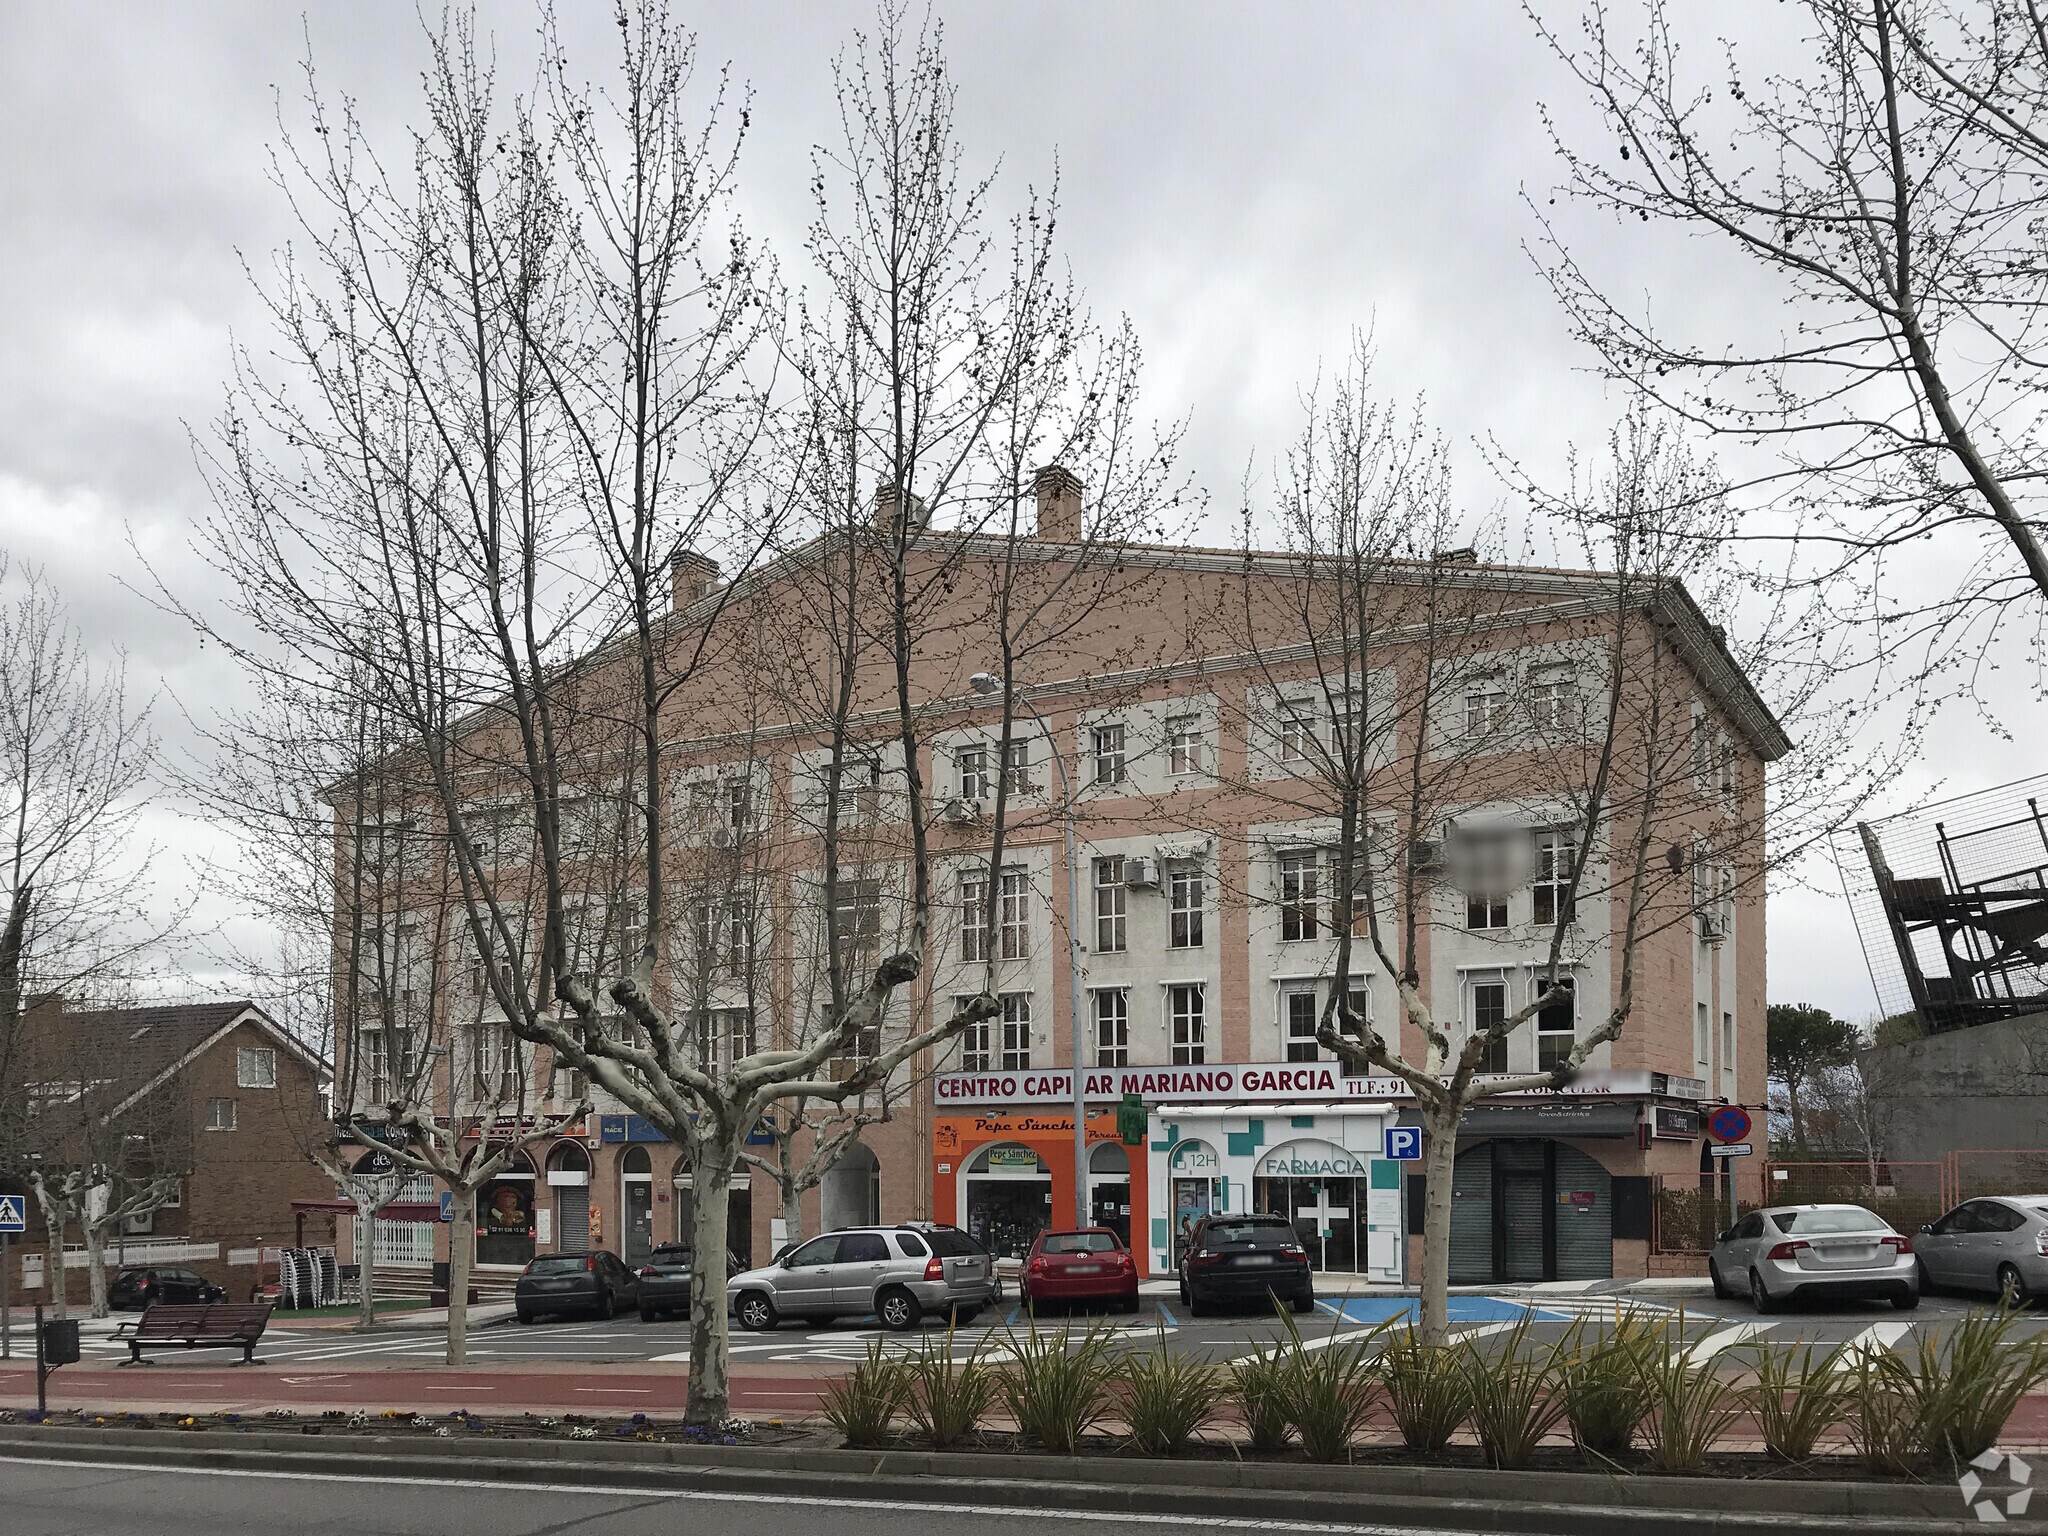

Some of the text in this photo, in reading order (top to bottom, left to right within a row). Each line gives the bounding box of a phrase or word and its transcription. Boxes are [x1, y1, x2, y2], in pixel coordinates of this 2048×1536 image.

[937, 1070, 1335, 1098] CENTRO CAPIAR MARIANO GARCIA
[1346, 1080, 1406, 1094] TLF.: 91
[975, 1119, 1013, 1133] Pepe
[1392, 1131, 1414, 1157] P
[990, 1149, 1036, 1159] Pepe Sánchez
[1190, 1154, 1217, 1168] 12H
[1266, 1159, 1366, 1175] FARMACIA
